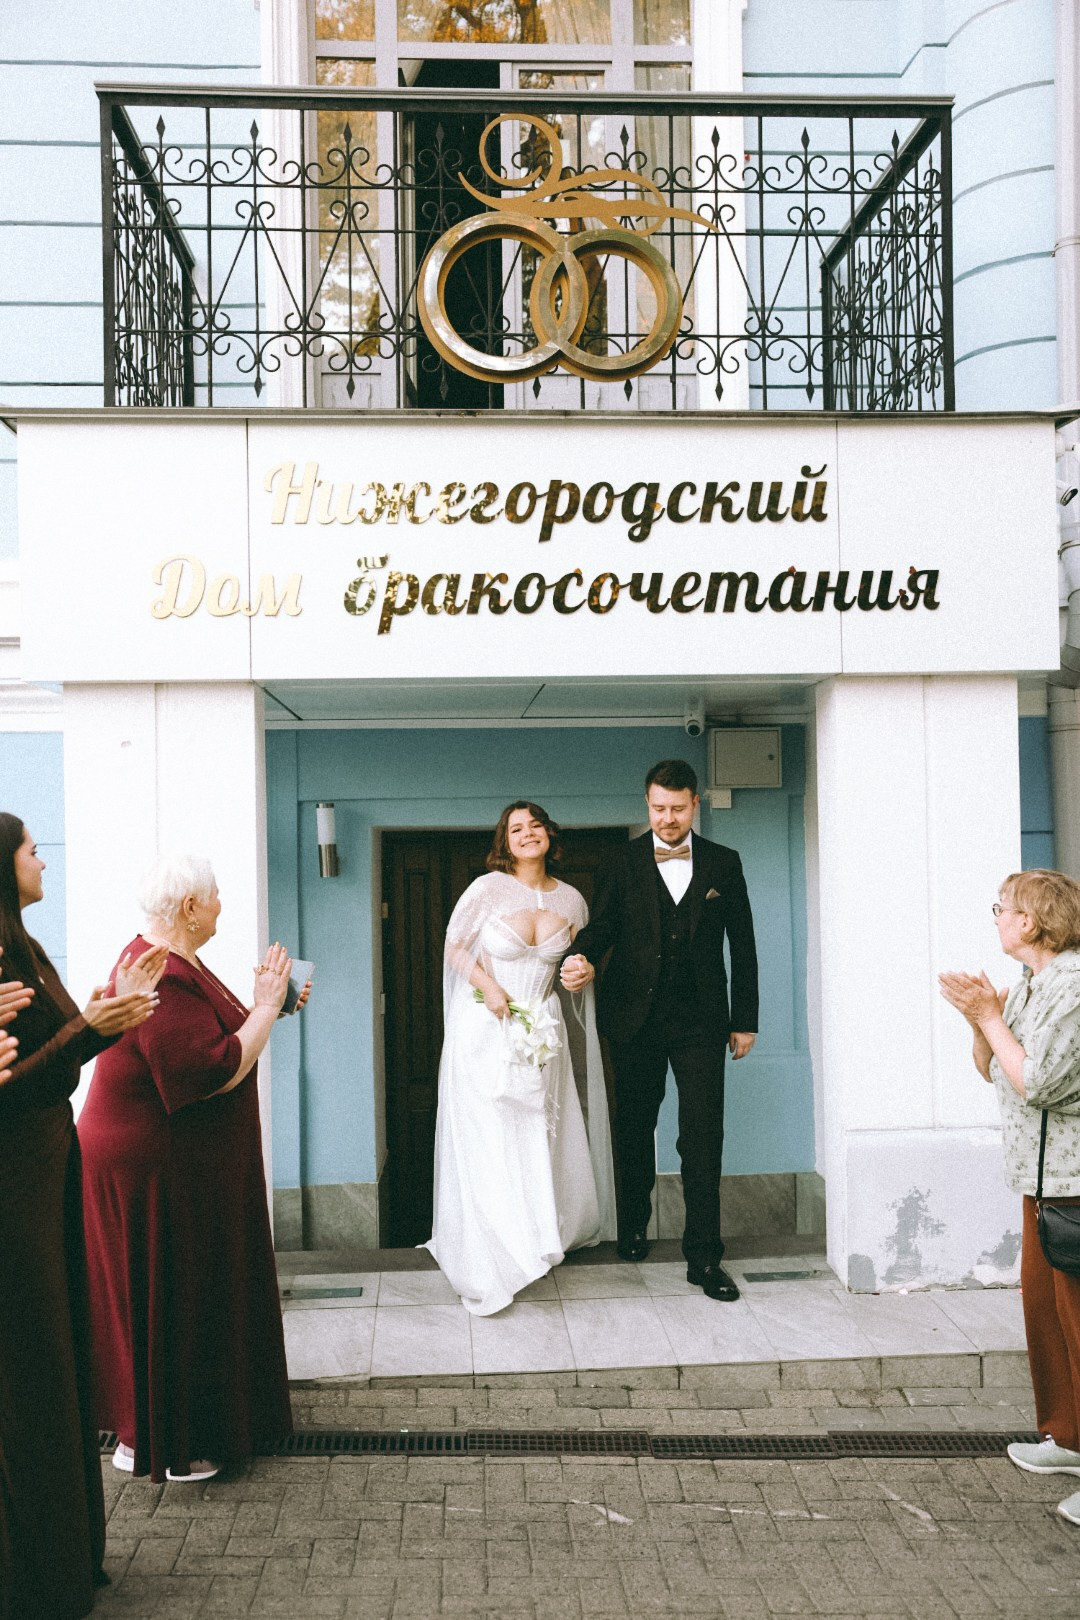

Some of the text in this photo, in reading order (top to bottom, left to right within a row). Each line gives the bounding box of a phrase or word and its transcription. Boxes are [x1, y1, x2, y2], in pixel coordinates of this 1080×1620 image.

[263, 461, 828, 543] Нижегородский
[151, 552, 941, 636] Дом бракосочетания
